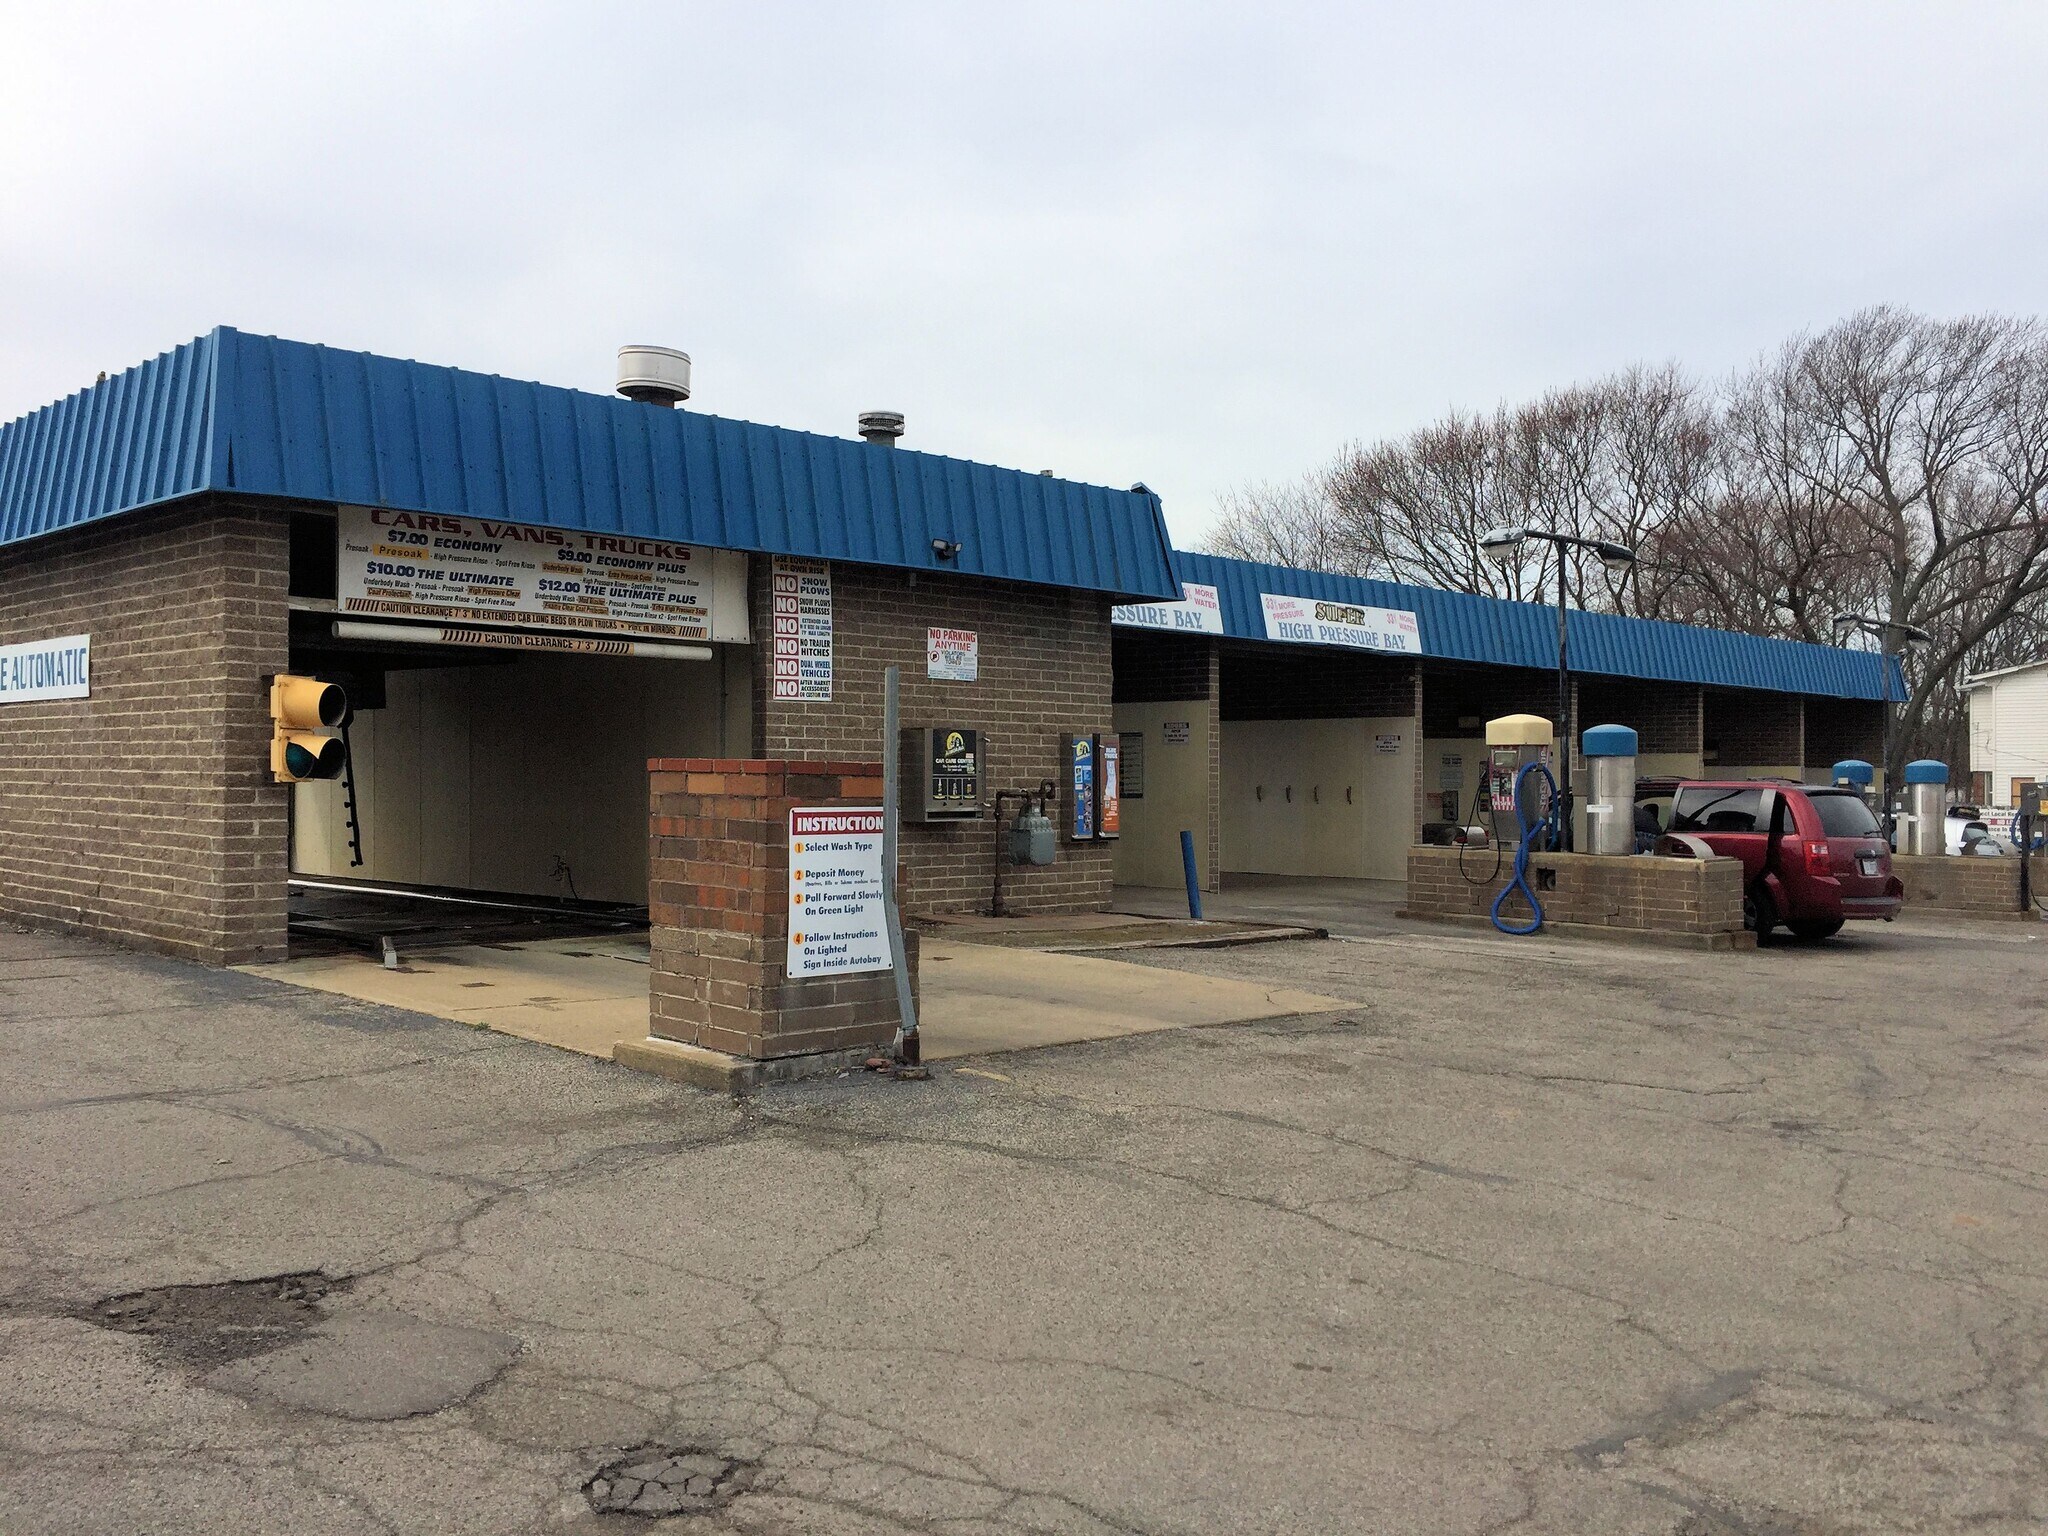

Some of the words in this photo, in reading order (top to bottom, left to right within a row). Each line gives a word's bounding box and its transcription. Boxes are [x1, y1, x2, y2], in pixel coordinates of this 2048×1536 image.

[371, 509, 472, 538] CARS,
[481, 521, 573, 549] VANS,
[581, 535, 691, 561] TRUCKS
[388, 529, 428, 545] $7.00
[434, 537, 502, 553] ECONOMY
[379, 546, 422, 558] Presoak
[434, 553, 446, 562] High
[448, 554, 472, 563] Pressure
[473, 556, 488, 565] Rinse
[495, 559, 508, 567] Spot
[509, 560, 520, 568] Free
[521, 561, 536, 569] Rinse
[558, 549, 592, 564] $9.00
[597, 556, 654, 571] ECONOMY
[657, 563, 687, 574] PLUS
[367, 561, 416, 578] $10.00
[417, 569, 445, 581] THE
[449, 571, 515, 587] ULTIMATE
[802, 577, 828, 587] SNOW
[363, 577, 394, 588] Underbody
[395, 580, 410, 588] Wash
[415, 582, 438, 591] Presoak
[442, 584, 464, 593] Presoak
[539, 578, 580, 593] $12.00
[585, 585, 606, 596] THE
[609, 586, 666, 602] ULTIMATE
[668, 594, 697, 605] PLUS
[776, 576, 797, 592] NO
[800, 586, 830, 596] PLOWS
[414, 591, 428, 601] High
[429, 593, 453, 602] Pressure
[455, 595, 470, 603] Rinse
[475, 597, 488, 605] Spot
[488, 597, 500, 605] Free
[500, 599, 516, 607] Rinse
[1194, 587, 1215, 600] MORE
[776, 597, 798, 613] NO
[800, 606, 830, 615] HARNESSES
[1193, 596, 1219, 611] WATER
[1278, 601, 1296, 611] MORE
[381, 603, 412, 614] CAUTION
[413, 605, 453, 617] CLEARANCE
[472, 610, 481, 619] NO
[482, 611, 516, 622] EXTENDED
[517, 613, 531, 623] CAB
[532, 614, 549, 624] LONG
[550, 616, 567, 626] BEDS
[568, 618, 577, 626] OR
[577, 618, 593, 628] PLOW
[594, 619, 618, 630] TRUCKS
[1173, 608, 1204, 630] BAY
[1272, 609, 1305, 621] PRESSURE
[1315, 602, 1366, 627] SUPER
[1399, 613, 1415, 625] MORE
[777, 618, 798, 634] NO
[1399, 622, 1418, 634] WATER
[485, 633, 522, 645] CAUTION
[524, 636, 573, 649] CLEARANCE
[800, 639, 808, 647] NO
[809, 639, 830, 648] TRAILER
[930, 628, 941, 640] NO
[943, 630, 976, 644] PARKING
[1277, 621, 1315, 641] HIGH
[1317, 624, 1380, 648] PRESSURE
[1383, 632, 1406, 650] BAY
[777, 639, 798, 655] NO
[801, 648, 830, 657] HITCHES
[934, 640, 972, 653] ANYTIME
[10, 647, 87, 690] AUTOMATIC
[777, 660, 798, 676] NO
[801, 660, 813, 668] DUAL
[801, 669, 830, 678] VEHICLES
[777, 681, 798, 697] NO
[797, 816, 883, 832] INSTRUCTION
[805, 843, 828, 852] Select
[831, 841, 853, 851] Wash
[855, 842, 873, 852] Type
[805, 868, 836, 880] Deposit
[838, 868, 865, 878] Money
[805, 892, 821, 903] Pull
[824, 890, 856, 901] Forward
[858, 889, 883, 900] Slowly
[805, 907, 816, 916] On
[818, 906, 842, 915] Green
[845, 904, 864, 915] Light
[805, 932, 831, 943] Follow
[833, 929, 878, 941] Instructions
[804, 946, 815, 956] On
[817, 944, 847, 956] Lighted
[803, 959, 821, 972] Sign
[824, 957, 848, 968] Inside
[850, 955, 882, 967] Autobay
